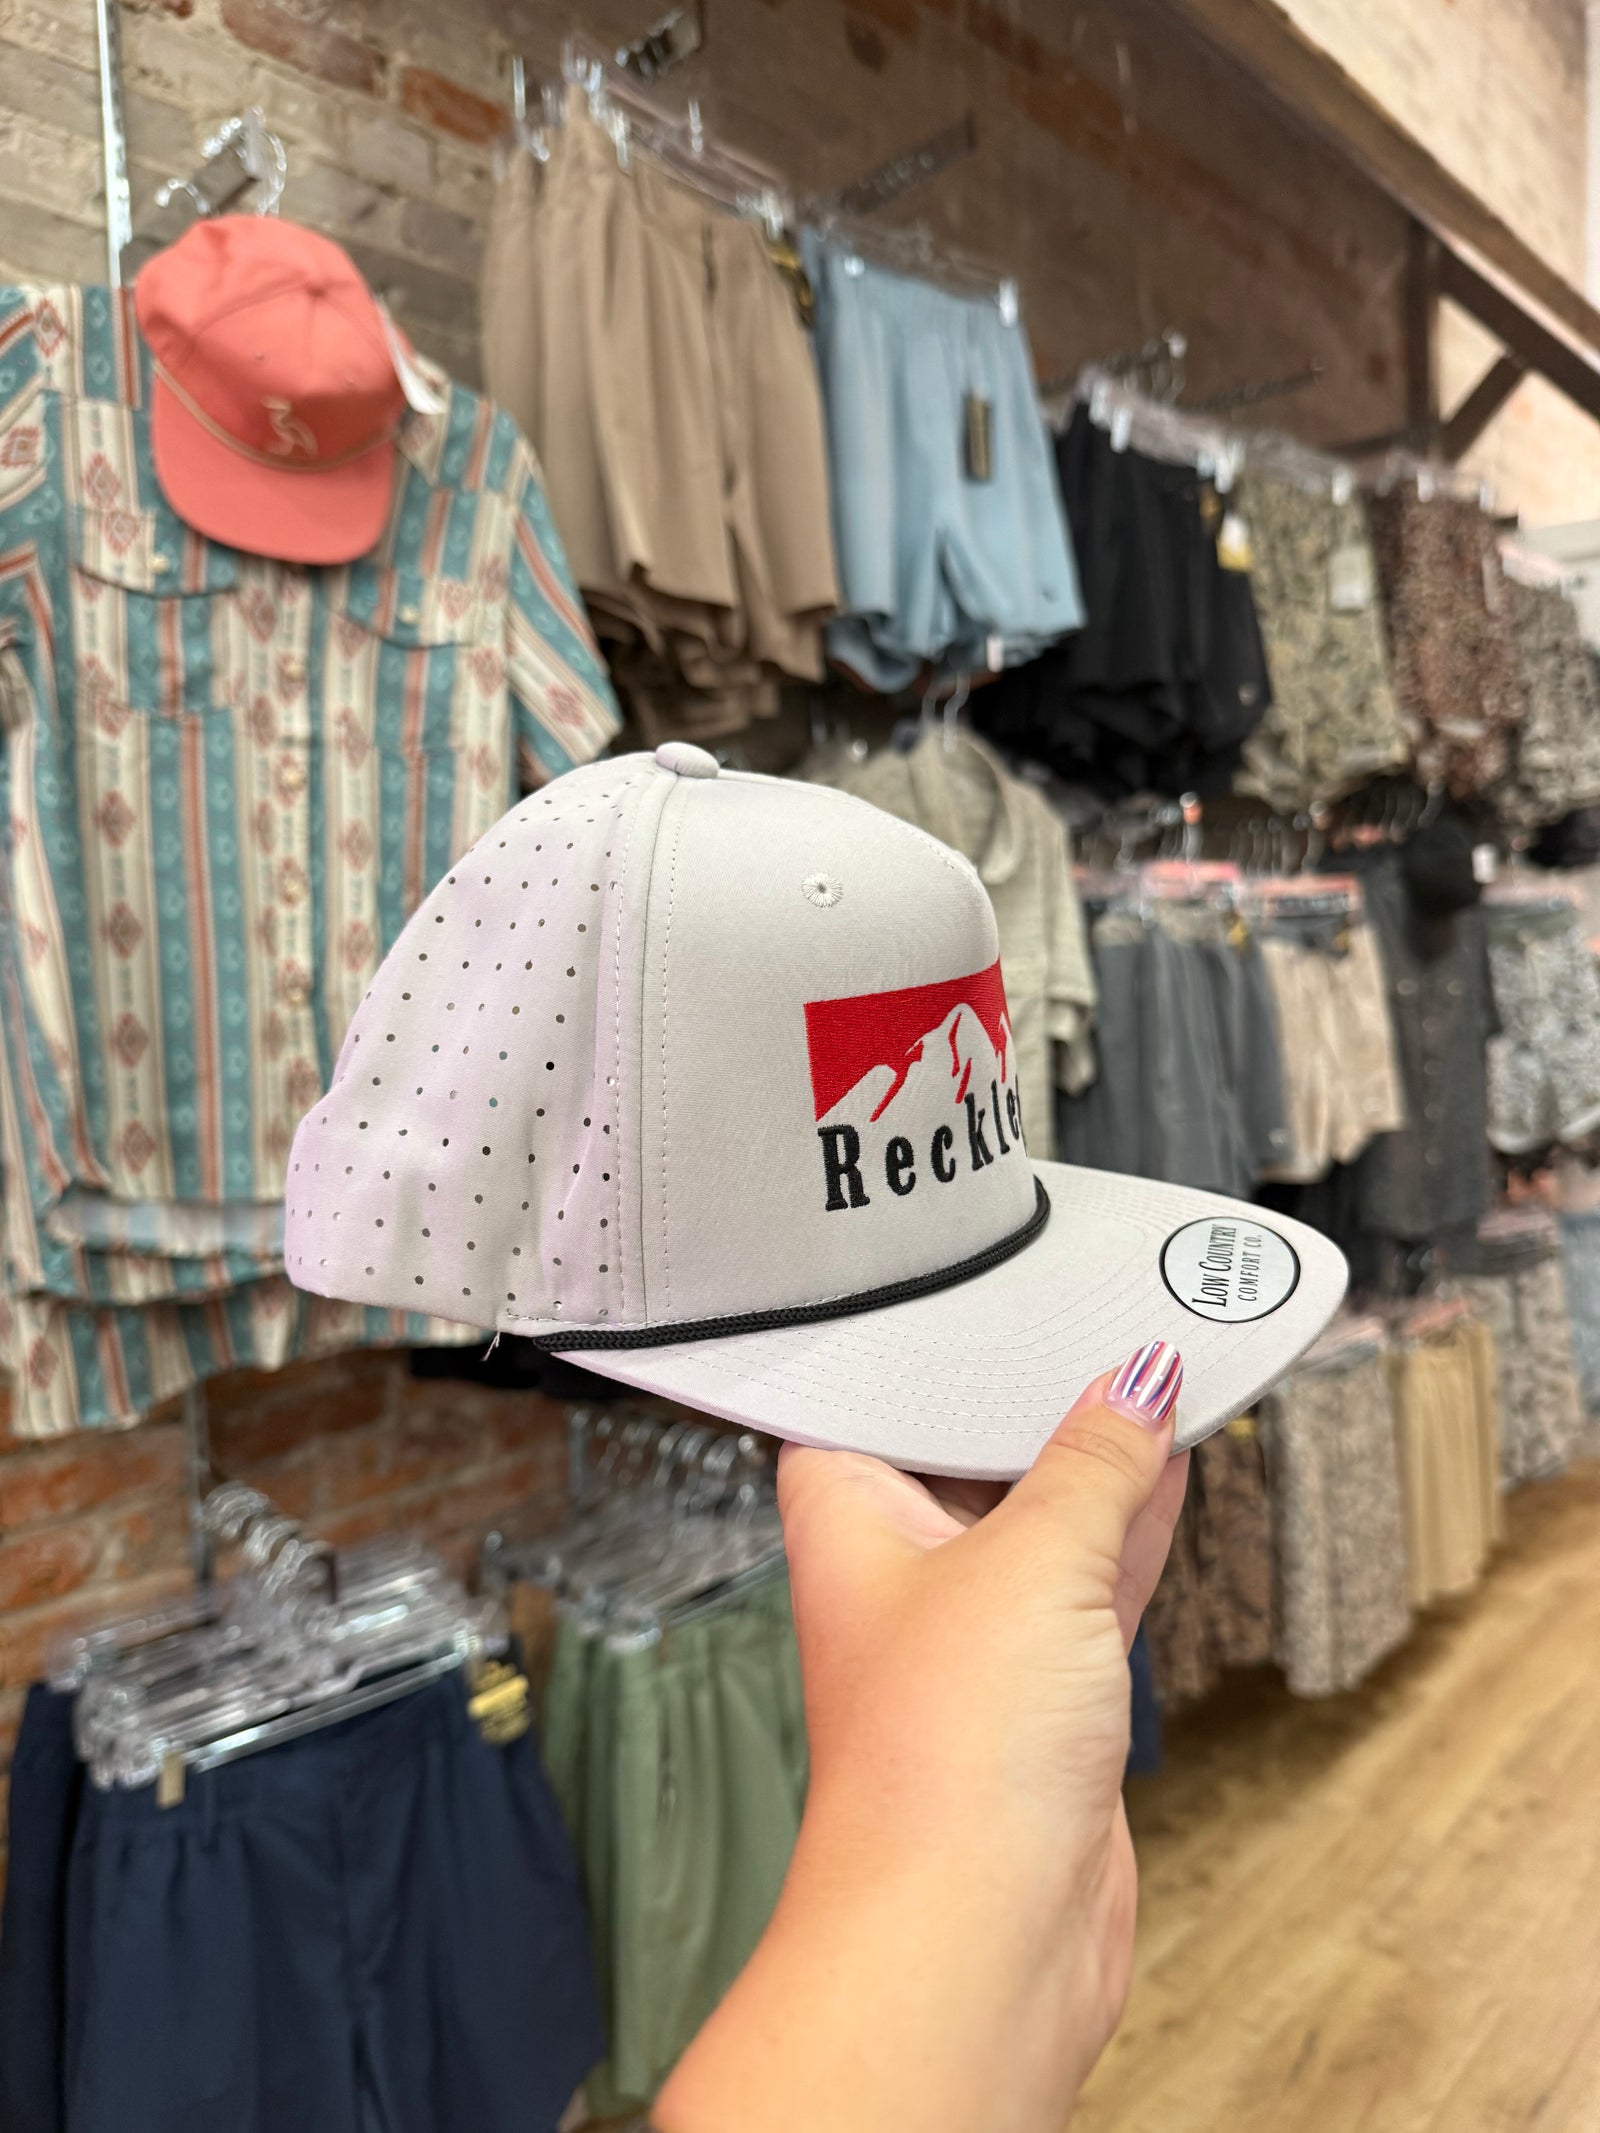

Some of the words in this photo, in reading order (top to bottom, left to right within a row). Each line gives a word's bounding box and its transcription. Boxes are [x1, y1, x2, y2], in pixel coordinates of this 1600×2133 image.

[817, 1075, 1027, 1212] Reckle
[1243, 1234, 1262, 1248] CO.
[1237, 1251, 1261, 1302] COMFORT
